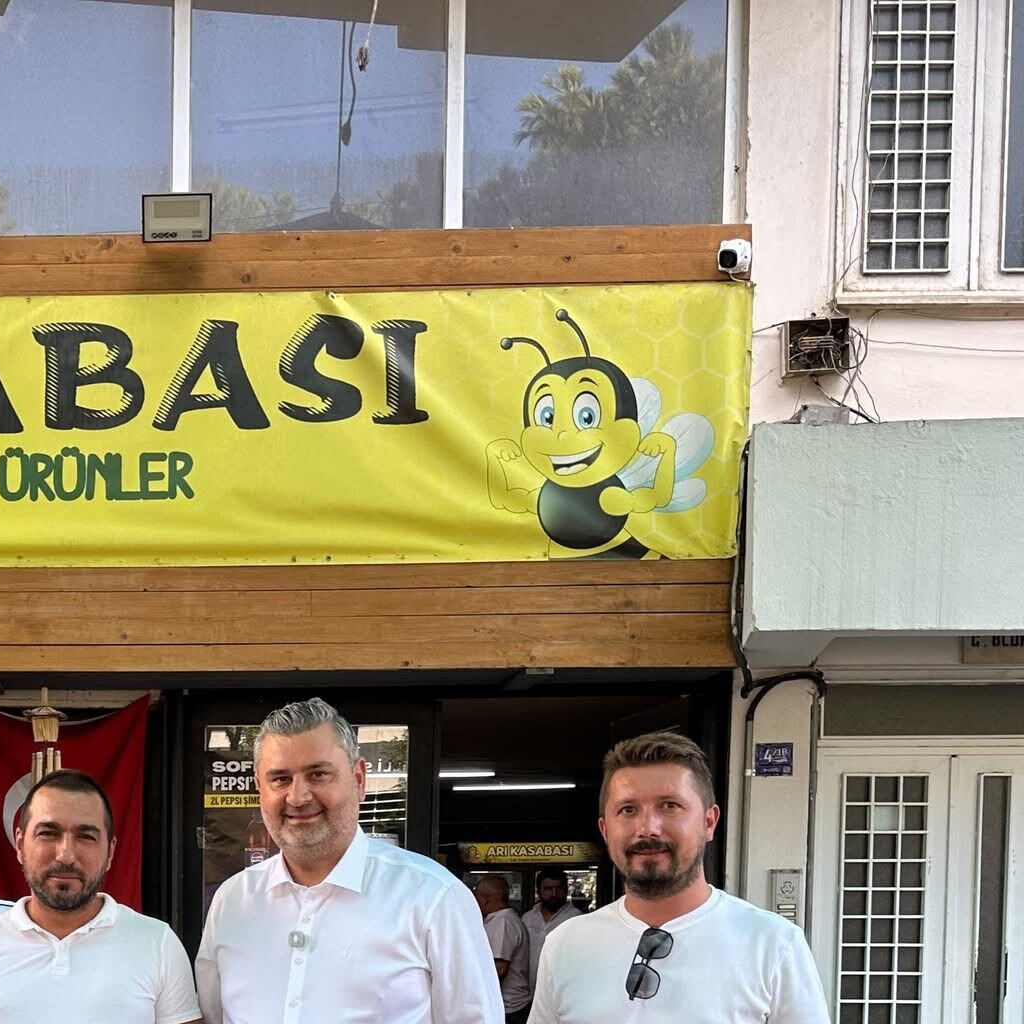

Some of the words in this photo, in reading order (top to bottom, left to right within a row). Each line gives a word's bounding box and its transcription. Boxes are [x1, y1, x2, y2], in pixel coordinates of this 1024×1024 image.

[212, 761, 257, 773] SOF
[212, 776, 260, 791] PEPSI'
[210, 797, 219, 805] 2L
[220, 797, 242, 805] PEPSI
[487, 847, 508, 857] ARI
[510, 845, 573, 857] KASABASI
